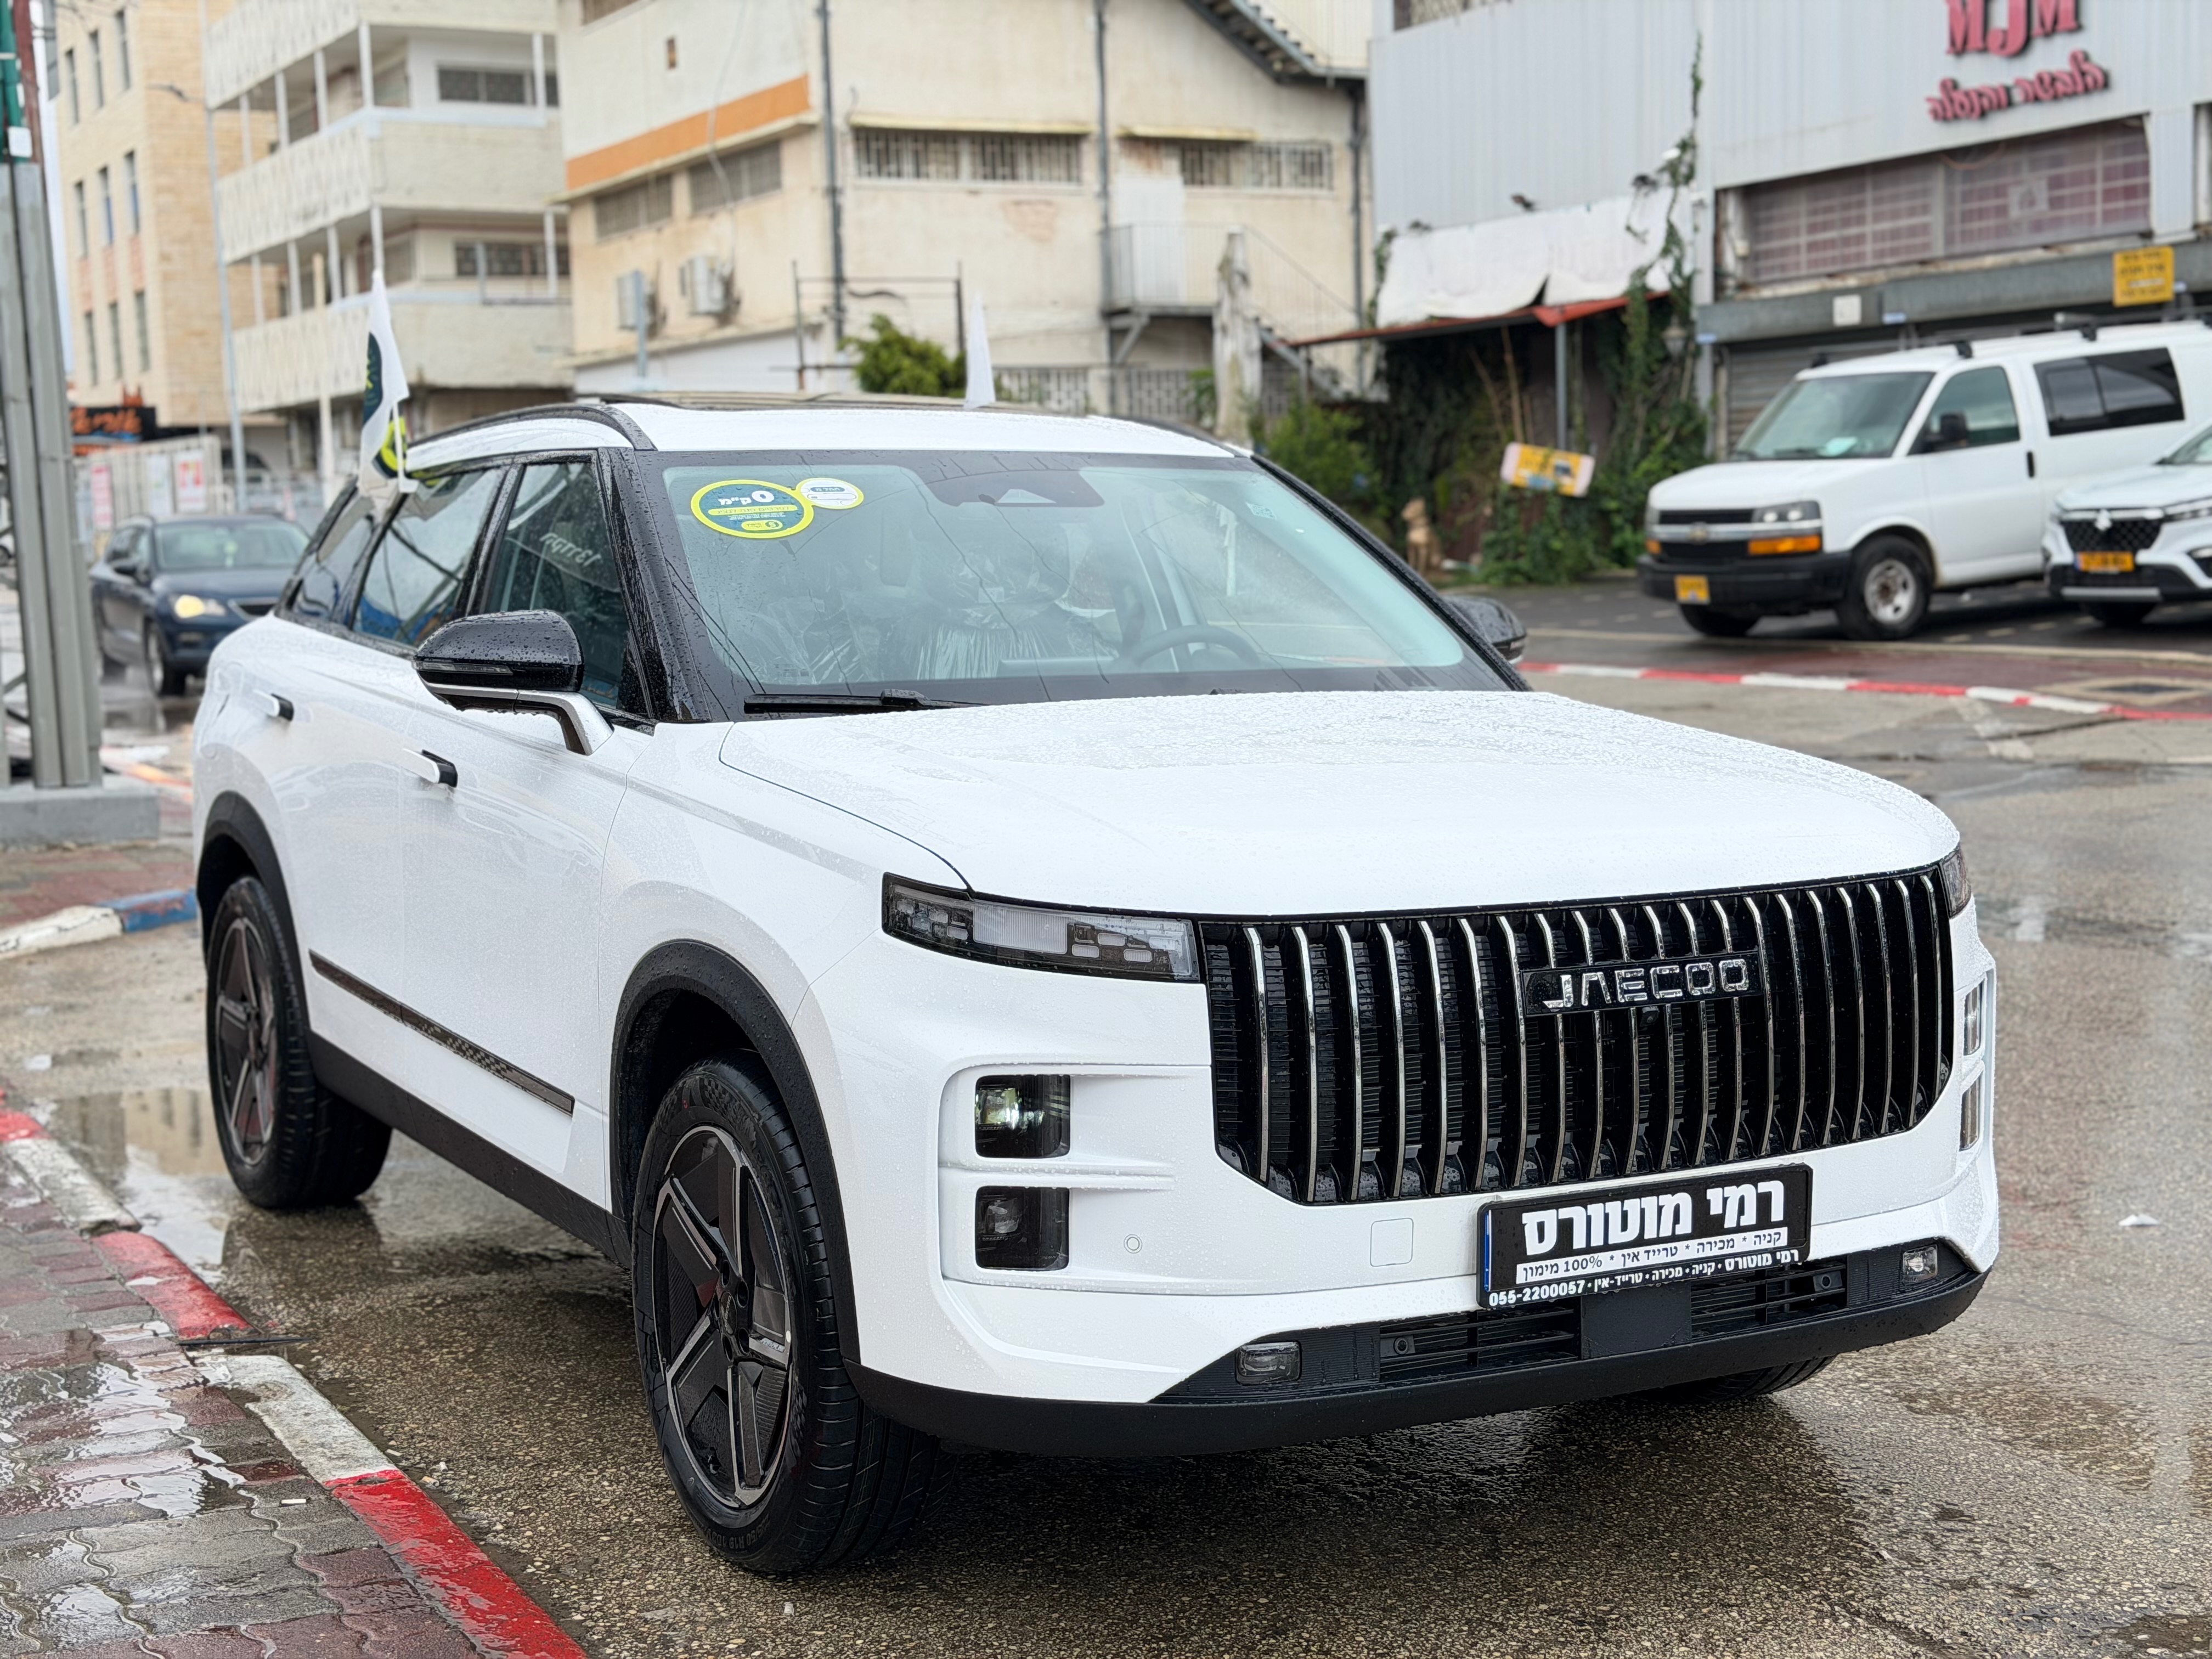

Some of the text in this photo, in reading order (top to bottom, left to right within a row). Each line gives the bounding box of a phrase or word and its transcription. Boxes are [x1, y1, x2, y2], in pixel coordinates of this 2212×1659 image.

[1944, 0, 2079, 57] MJM
[1926, 50, 2106, 121] הלבשה והנעלה
[751, 490, 775, 503] 0
[1543, 958, 1750, 1008] JAECOO
[1522, 1180, 1785, 1256] רמי מוטורס
[1489, 1249, 1799, 1307] רמי מוטורס קניה מכירה טרייד-אין 055-2200057
[1523, 1231, 1781, 1282] קניה מכירה טרייד אין 100% מימון
[729, 1536, 745, 1549] R19
[746, 1513, 770, 1545] 5/50
